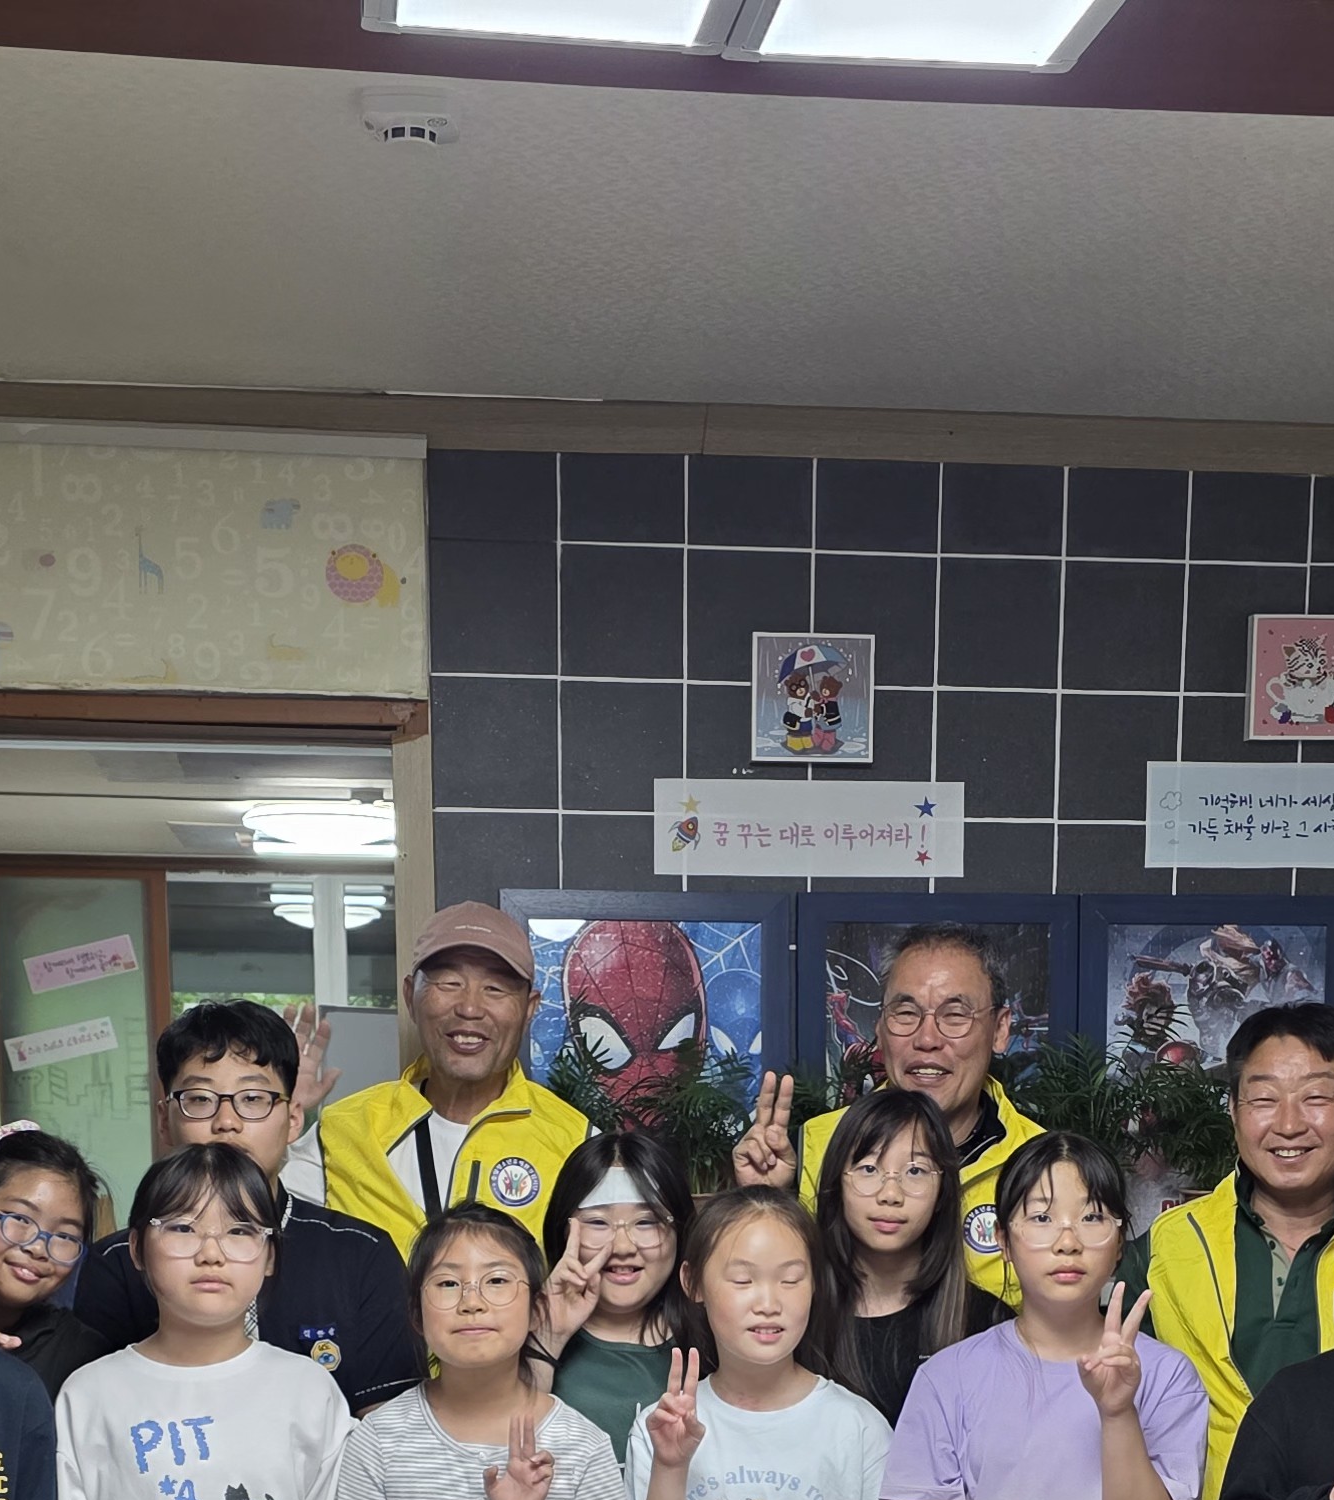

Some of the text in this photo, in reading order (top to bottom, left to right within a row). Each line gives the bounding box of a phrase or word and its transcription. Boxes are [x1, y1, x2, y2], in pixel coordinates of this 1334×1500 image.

[1199, 793, 1253, 814] 기억해!
[1259, 794, 1298, 808] 네가
[712, 821, 730, 847] 꿈
[736, 823, 772, 848] 꾸는
[779, 823, 817, 848] 대로
[823, 822, 913, 850] 이루어져라
[1188, 817, 1219, 841] 가득
[1224, 815, 1256, 841] 채울
[1261, 821, 1292, 839] 바로
[1295, 821, 1310, 838] 그
[130, 1415, 215, 1474] PIT
[725, 1465, 802, 1492] always
